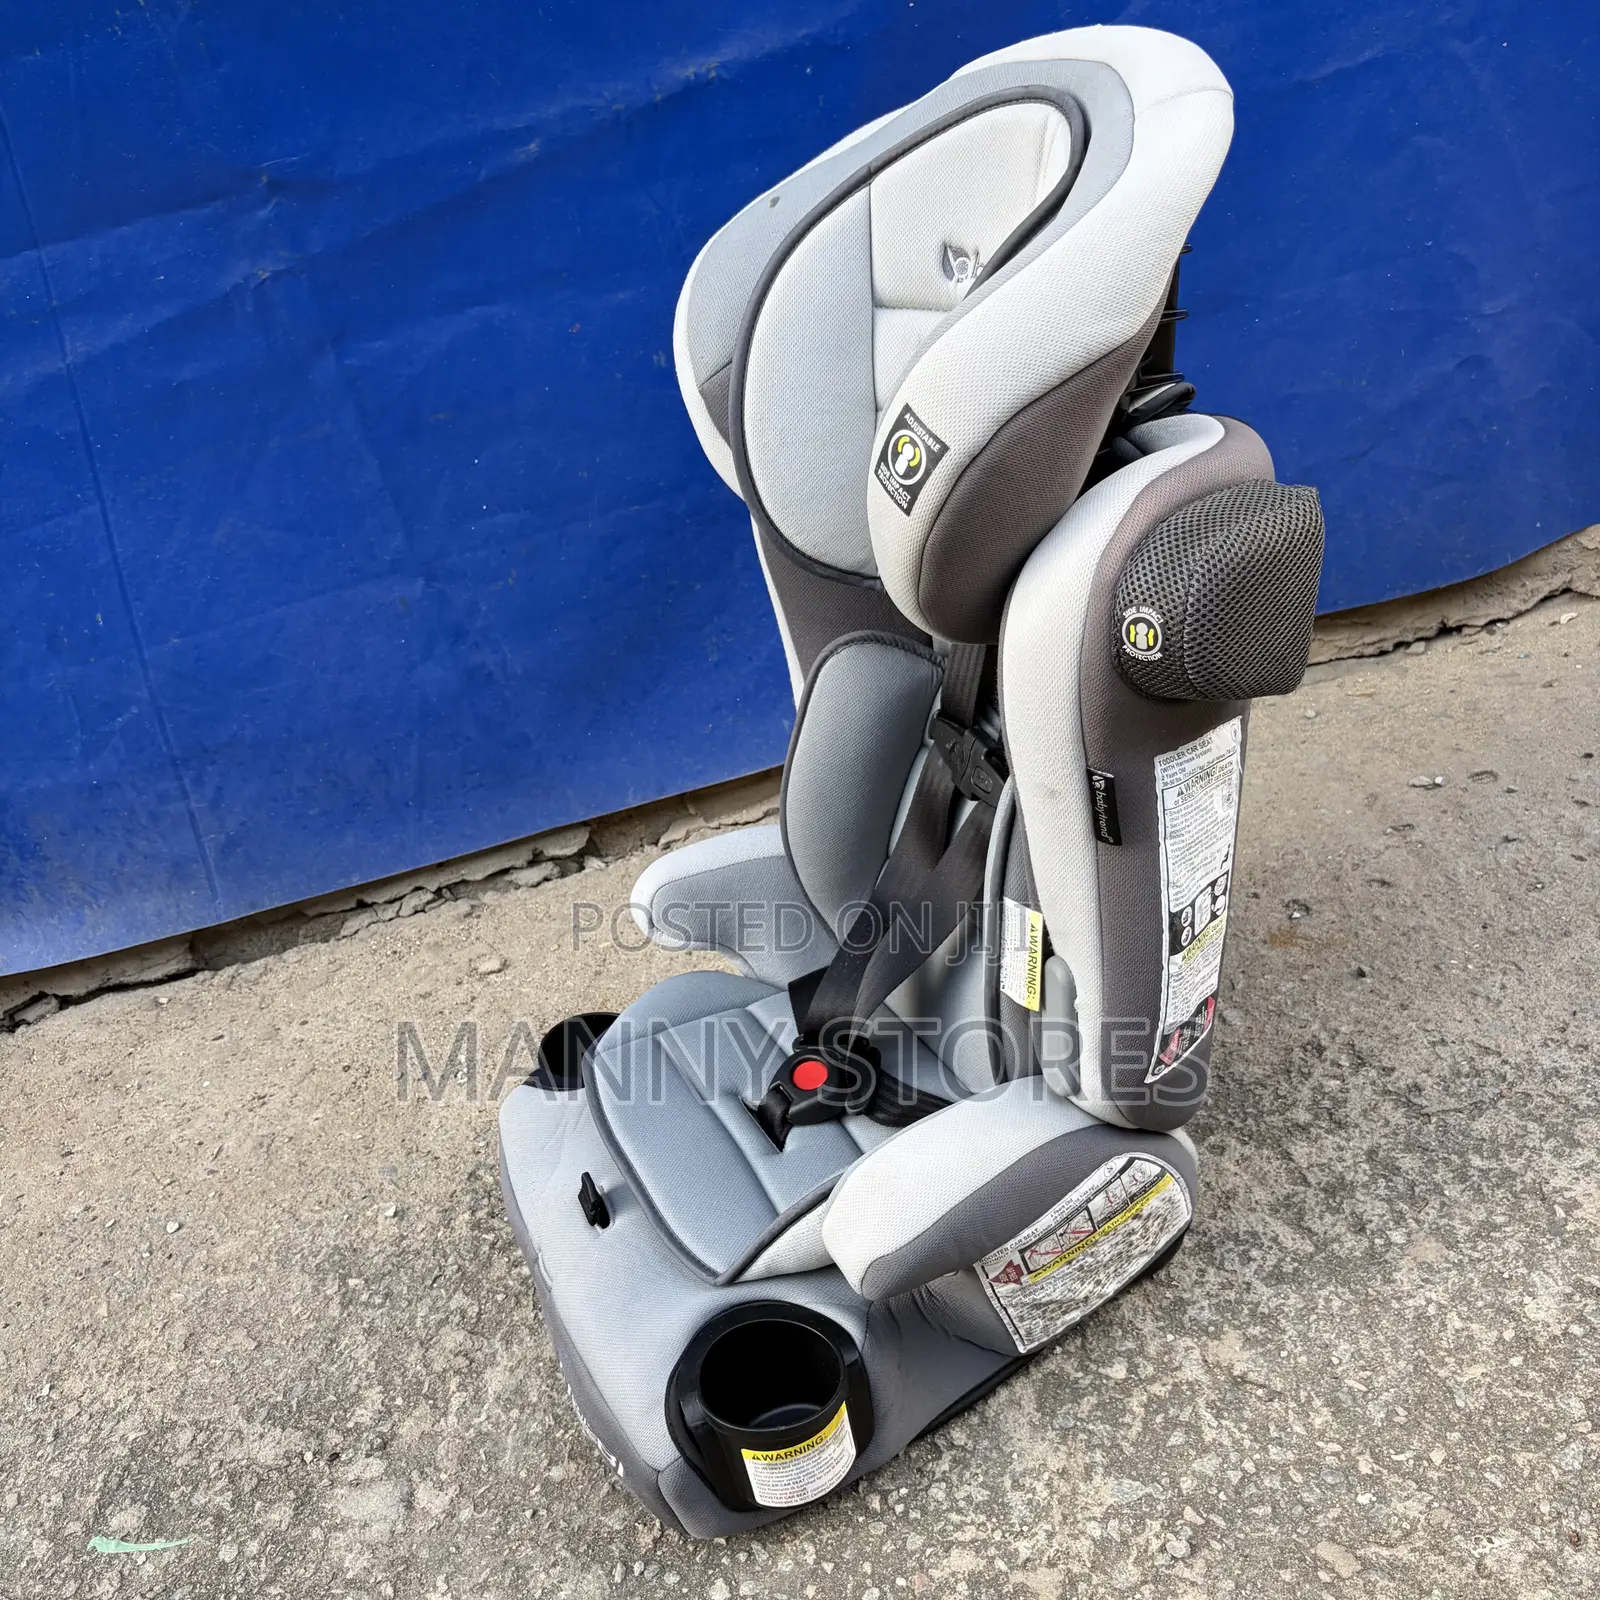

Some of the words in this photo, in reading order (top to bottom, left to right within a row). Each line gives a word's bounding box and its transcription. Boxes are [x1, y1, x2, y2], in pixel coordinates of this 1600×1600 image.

[904, 412, 941, 452] ADJUSTABLE
[877, 469, 908, 510] PROTECTION
[880, 462, 891, 479] SIDE
[889, 475, 911, 501] IMPACT
[1123, 607, 1137, 618] SIDE
[1140, 606, 1164, 624] IMPACT
[1122, 645, 1163, 661] PROTECTION
[1158, 752, 1186, 768] TODDLER
[1186, 745, 1198, 755] CAR
[1198, 737, 1214, 750] SEAT
[1176, 756, 1195, 768] Harness
[1166, 771, 1178, 779] Years
[1178, 767, 1186, 775] Old
[1184, 766, 1218, 793] WARNING!
[1218, 761, 1234, 773] DEATH
[1095, 790, 1110, 839] babytrend
[1026, 937, 1039, 999] WARNING:
[1010, 1238, 1023, 1250] CAR
[1023, 1228, 1039, 1240] SEAT
[1043, 1236, 1096, 1272] WARNING!
[761, 1432, 828, 1461] WARNING:
